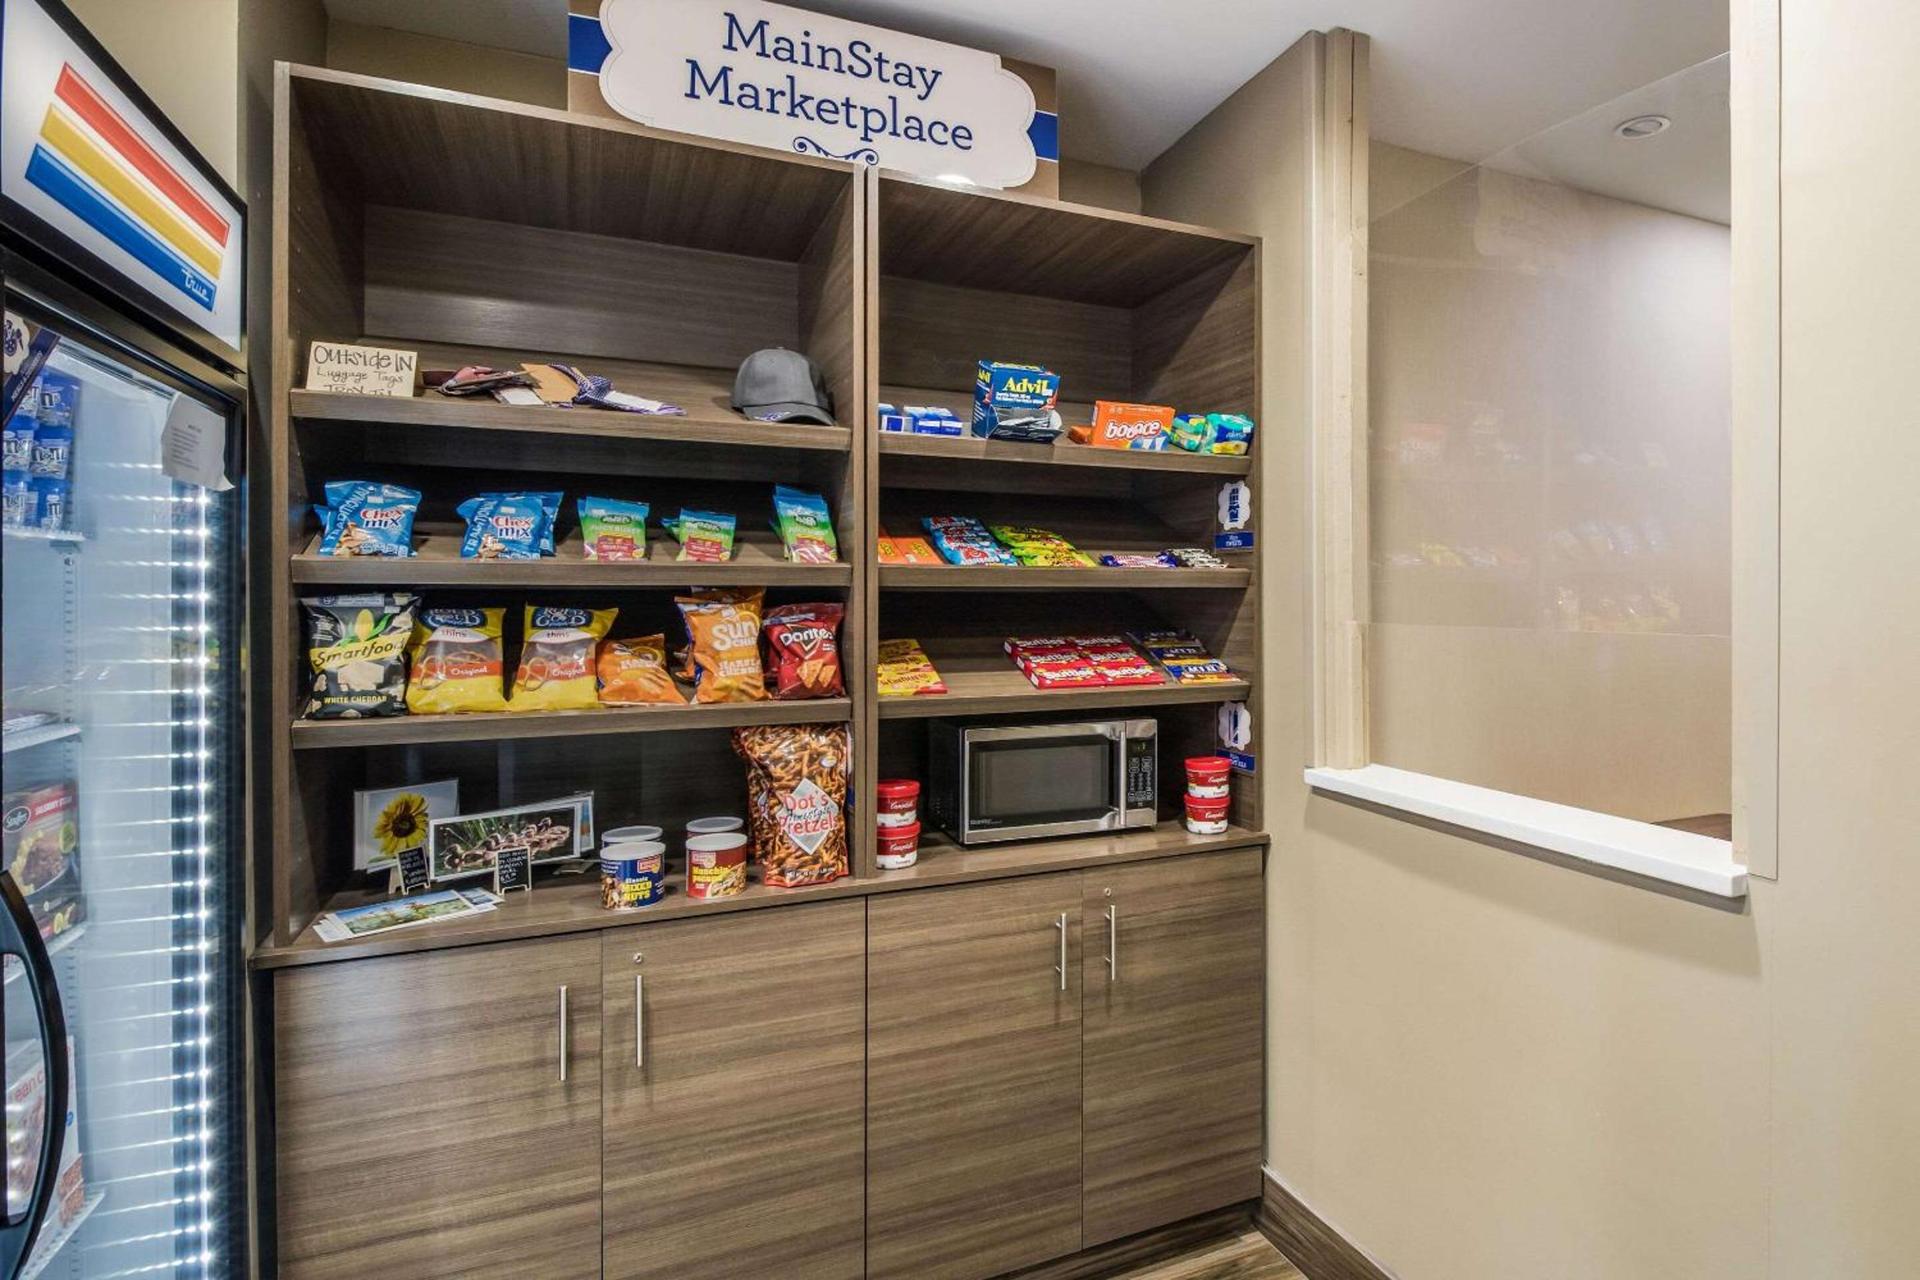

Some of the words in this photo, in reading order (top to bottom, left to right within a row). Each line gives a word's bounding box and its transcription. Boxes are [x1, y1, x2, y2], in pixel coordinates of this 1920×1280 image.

[722, 12, 942, 100] MainStay
[684, 59, 973, 151] Marketplace
[1003, 377, 1051, 394] Advil
[324, 696, 349, 704] WHITE
